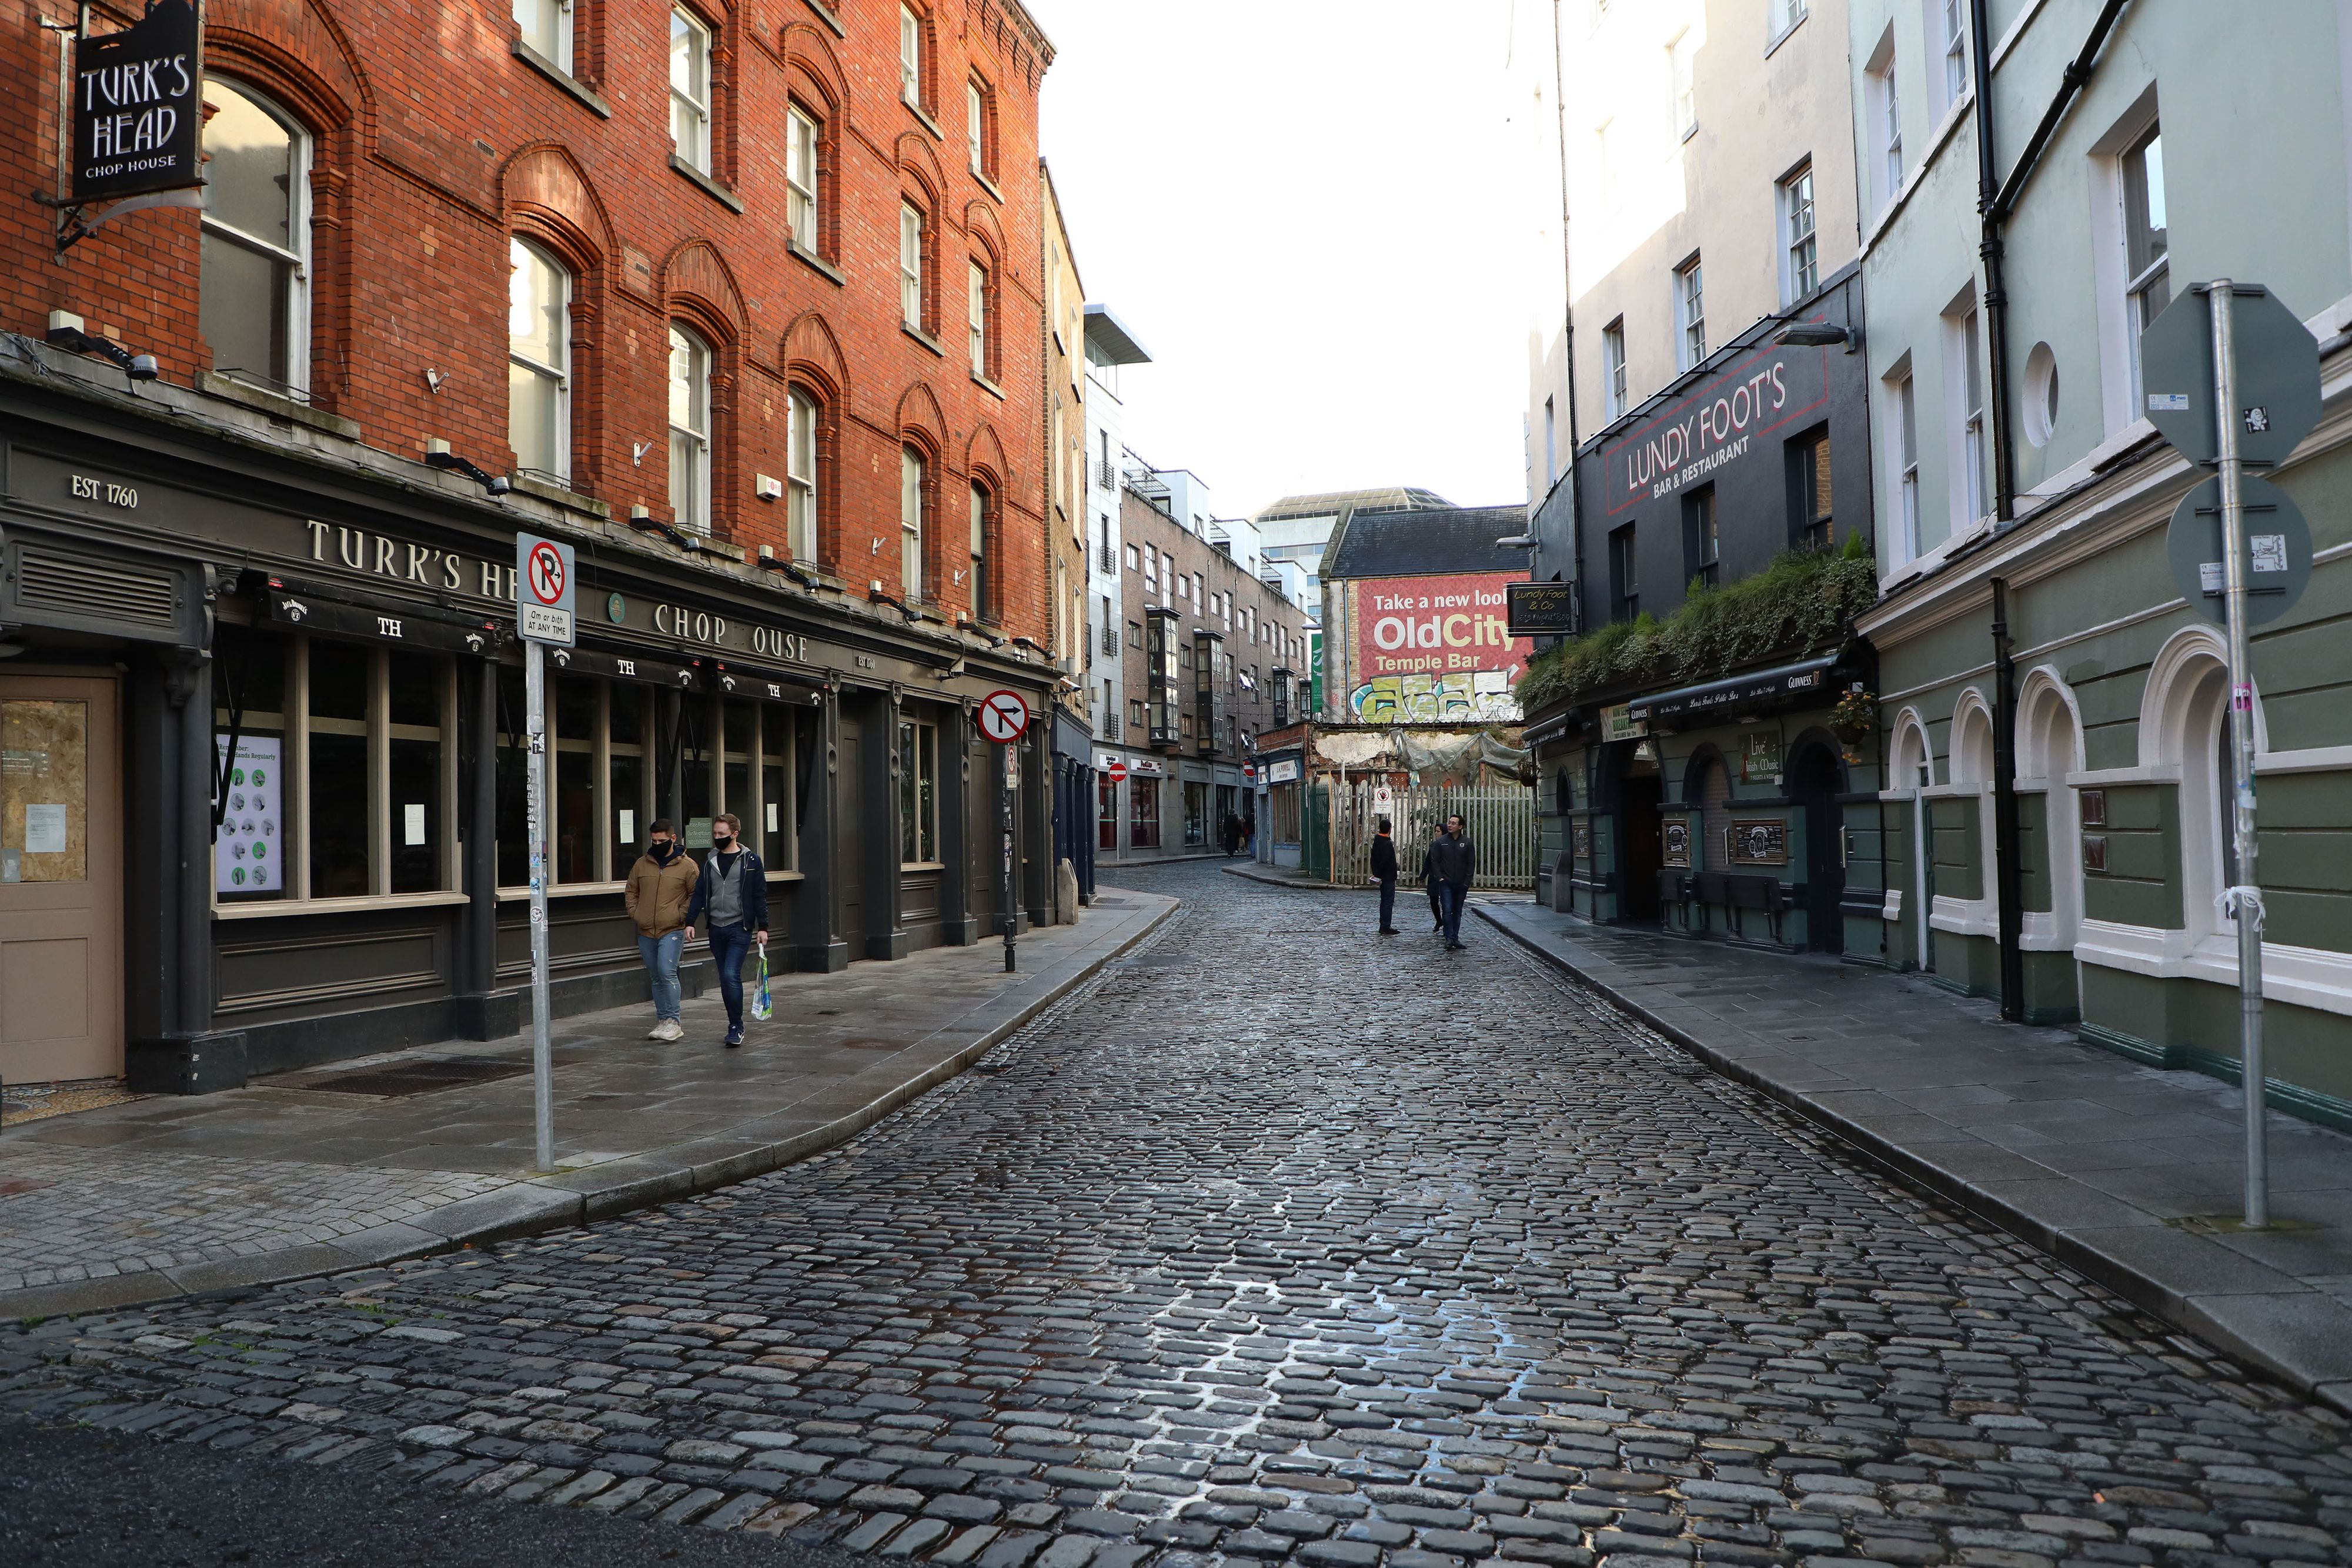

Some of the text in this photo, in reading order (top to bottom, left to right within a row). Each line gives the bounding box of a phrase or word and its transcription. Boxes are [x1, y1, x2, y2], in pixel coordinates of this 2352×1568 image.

[81, 54, 190, 111] TURK'S
[93, 105, 176, 158] HEAD
[86, 155, 176, 178] CHOP HOUSE
[1628, 362, 1786, 490] LUNDY FOOT'S
[1653, 435, 1749, 499] BAR & RESTAURANT
[72, 474, 138, 508] EST 1760
[306, 520, 517, 601] TURK'S HE
[1374, 594, 1414, 610] Take
[1419, 597, 1429, 609] a
[1435, 594, 1469, 608] new
[1514, 589, 1568, 600] Lundy Foot
[1529, 601, 1555, 610] & Co
[377, 616, 403, 638] TH
[529, 621, 566, 636] AT ANY TIME
[552, 615, 563, 624] bith
[654, 604, 807, 662] CHOP OUSE
[1374, 613, 1515, 651] OldCity
[617, 658, 636, 676] TH
[1375, 653, 1481, 673] Temple Bar
[768, 684, 781, 697] TH
[1788, 675, 1812, 688] GUINNESS
[1750, 734, 1766, 755] Live
[1745, 758, 1779, 772] Irish Music
